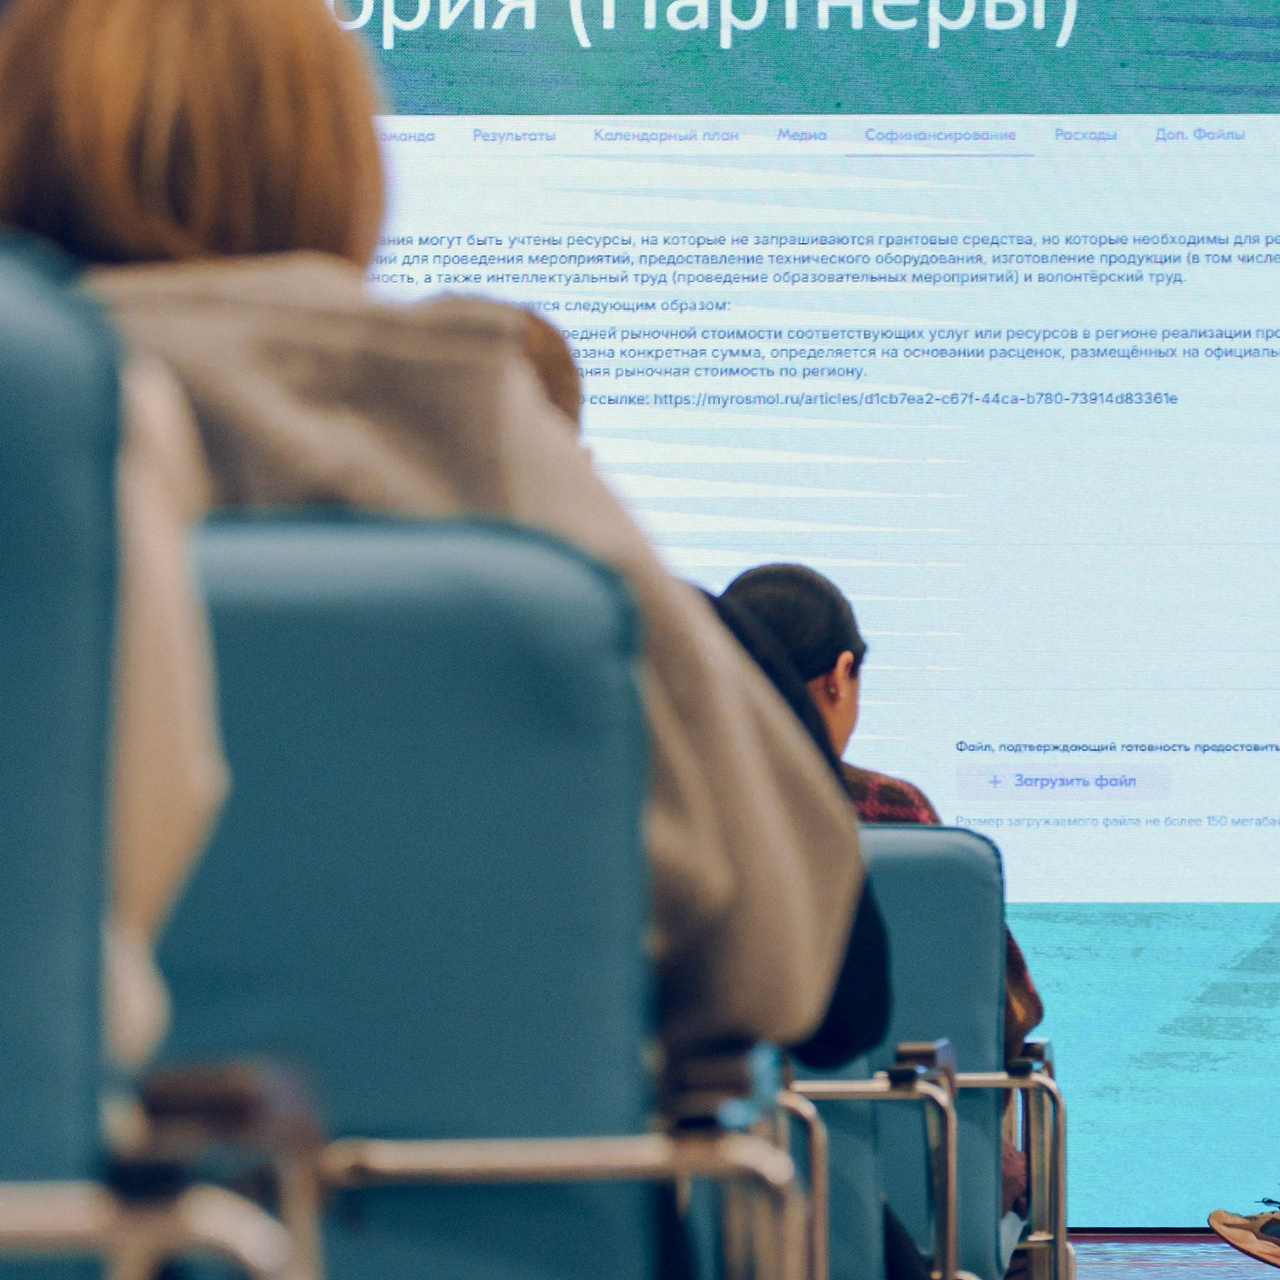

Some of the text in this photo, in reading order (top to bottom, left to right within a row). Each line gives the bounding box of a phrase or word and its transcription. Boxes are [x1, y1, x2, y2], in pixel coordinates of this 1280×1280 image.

[379, 132, 436, 144] оманда
[471, 128, 557, 144] Результаты
[592, 128, 741, 144] Календарный план
[776, 128, 829, 143] Медиа
[1052, 127, 1119, 143] Расходы
[1192, 127, 1247, 141] Файлы
[379, 235, 415, 246] ания
[417, 235, 463, 249] могут
[465, 232, 504, 246] быть
[507, 235, 563, 249] учтены
[640, 235, 659, 246] на
[662, 235, 727, 249] которые
[730, 235, 750, 246] не
[753, 235, 876, 249] запрашиваются
[877, 235, 959, 248] грантовые
[1041, 234, 1061, 245] но
[1063, 234, 1130, 248] которые
[1131, 231, 1230, 247] необходимы
[1232, 234, 1261, 247] для
[371, 252, 397, 265] ний
[402, 254, 429, 267] для
[432, 254, 524, 268] проведения
[638, 254, 764, 268] предоставление
[769, 254, 870, 265] технического
[992, 254, 1095, 265] изготовление
[1100, 254, 1182, 267] продукции
[1186, 251, 1201, 267] (в
[1204, 253, 1233, 264] том
[366, 273, 419, 285] ность,
[424, 273, 432, 283] а
[438, 273, 481, 283] также
[487, 270, 629, 286] интеллектуальный
[634, 273, 668, 286] труд
[672, 270, 768, 286] (проведение
[773, 270, 907, 286] образовательных
[1023, 273, 1033, 283] и
[1037, 270, 1144, 286] волонтёрский
[564, 301, 657, 314] следующим
[562, 326, 617, 342] редней
[620, 326, 697, 342] рыночной
[701, 328, 783, 340] стоимости
[787, 328, 924, 342] соответствующих
[928, 328, 969, 342] услуг
[974, 328, 1002, 339] или
[1006, 328, 1079, 342] ресурсов
[1082, 328, 1091, 339] в
[1094, 328, 1158, 342] регионе
[1161, 328, 1252, 342] реализации
[572, 348, 615, 359] азана
[620, 348, 707, 361] конкретная
[771, 348, 877, 361] определяется
[881, 348, 899, 359] на
[903, 348, 985, 358] основании
[1069, 345, 1178, 361] размещённых
[1182, 347, 1200, 358] на
[614, 367, 690, 380] рыночная
[694, 367, 775, 377] стоимость
[778, 367, 798, 377] по
[998, 740, 1117, 755] подтверждающий
[1120, 743, 1190, 753] готовность
[1014, 773, 1138, 792] Загрузить файл
[955, 814, 1004, 830] Размер
[1102, 814, 1141, 830] файла
[1145, 817, 1160, 827] не
[1164, 814, 1203, 827] более
[1206, 814, 1228, 827] 150
